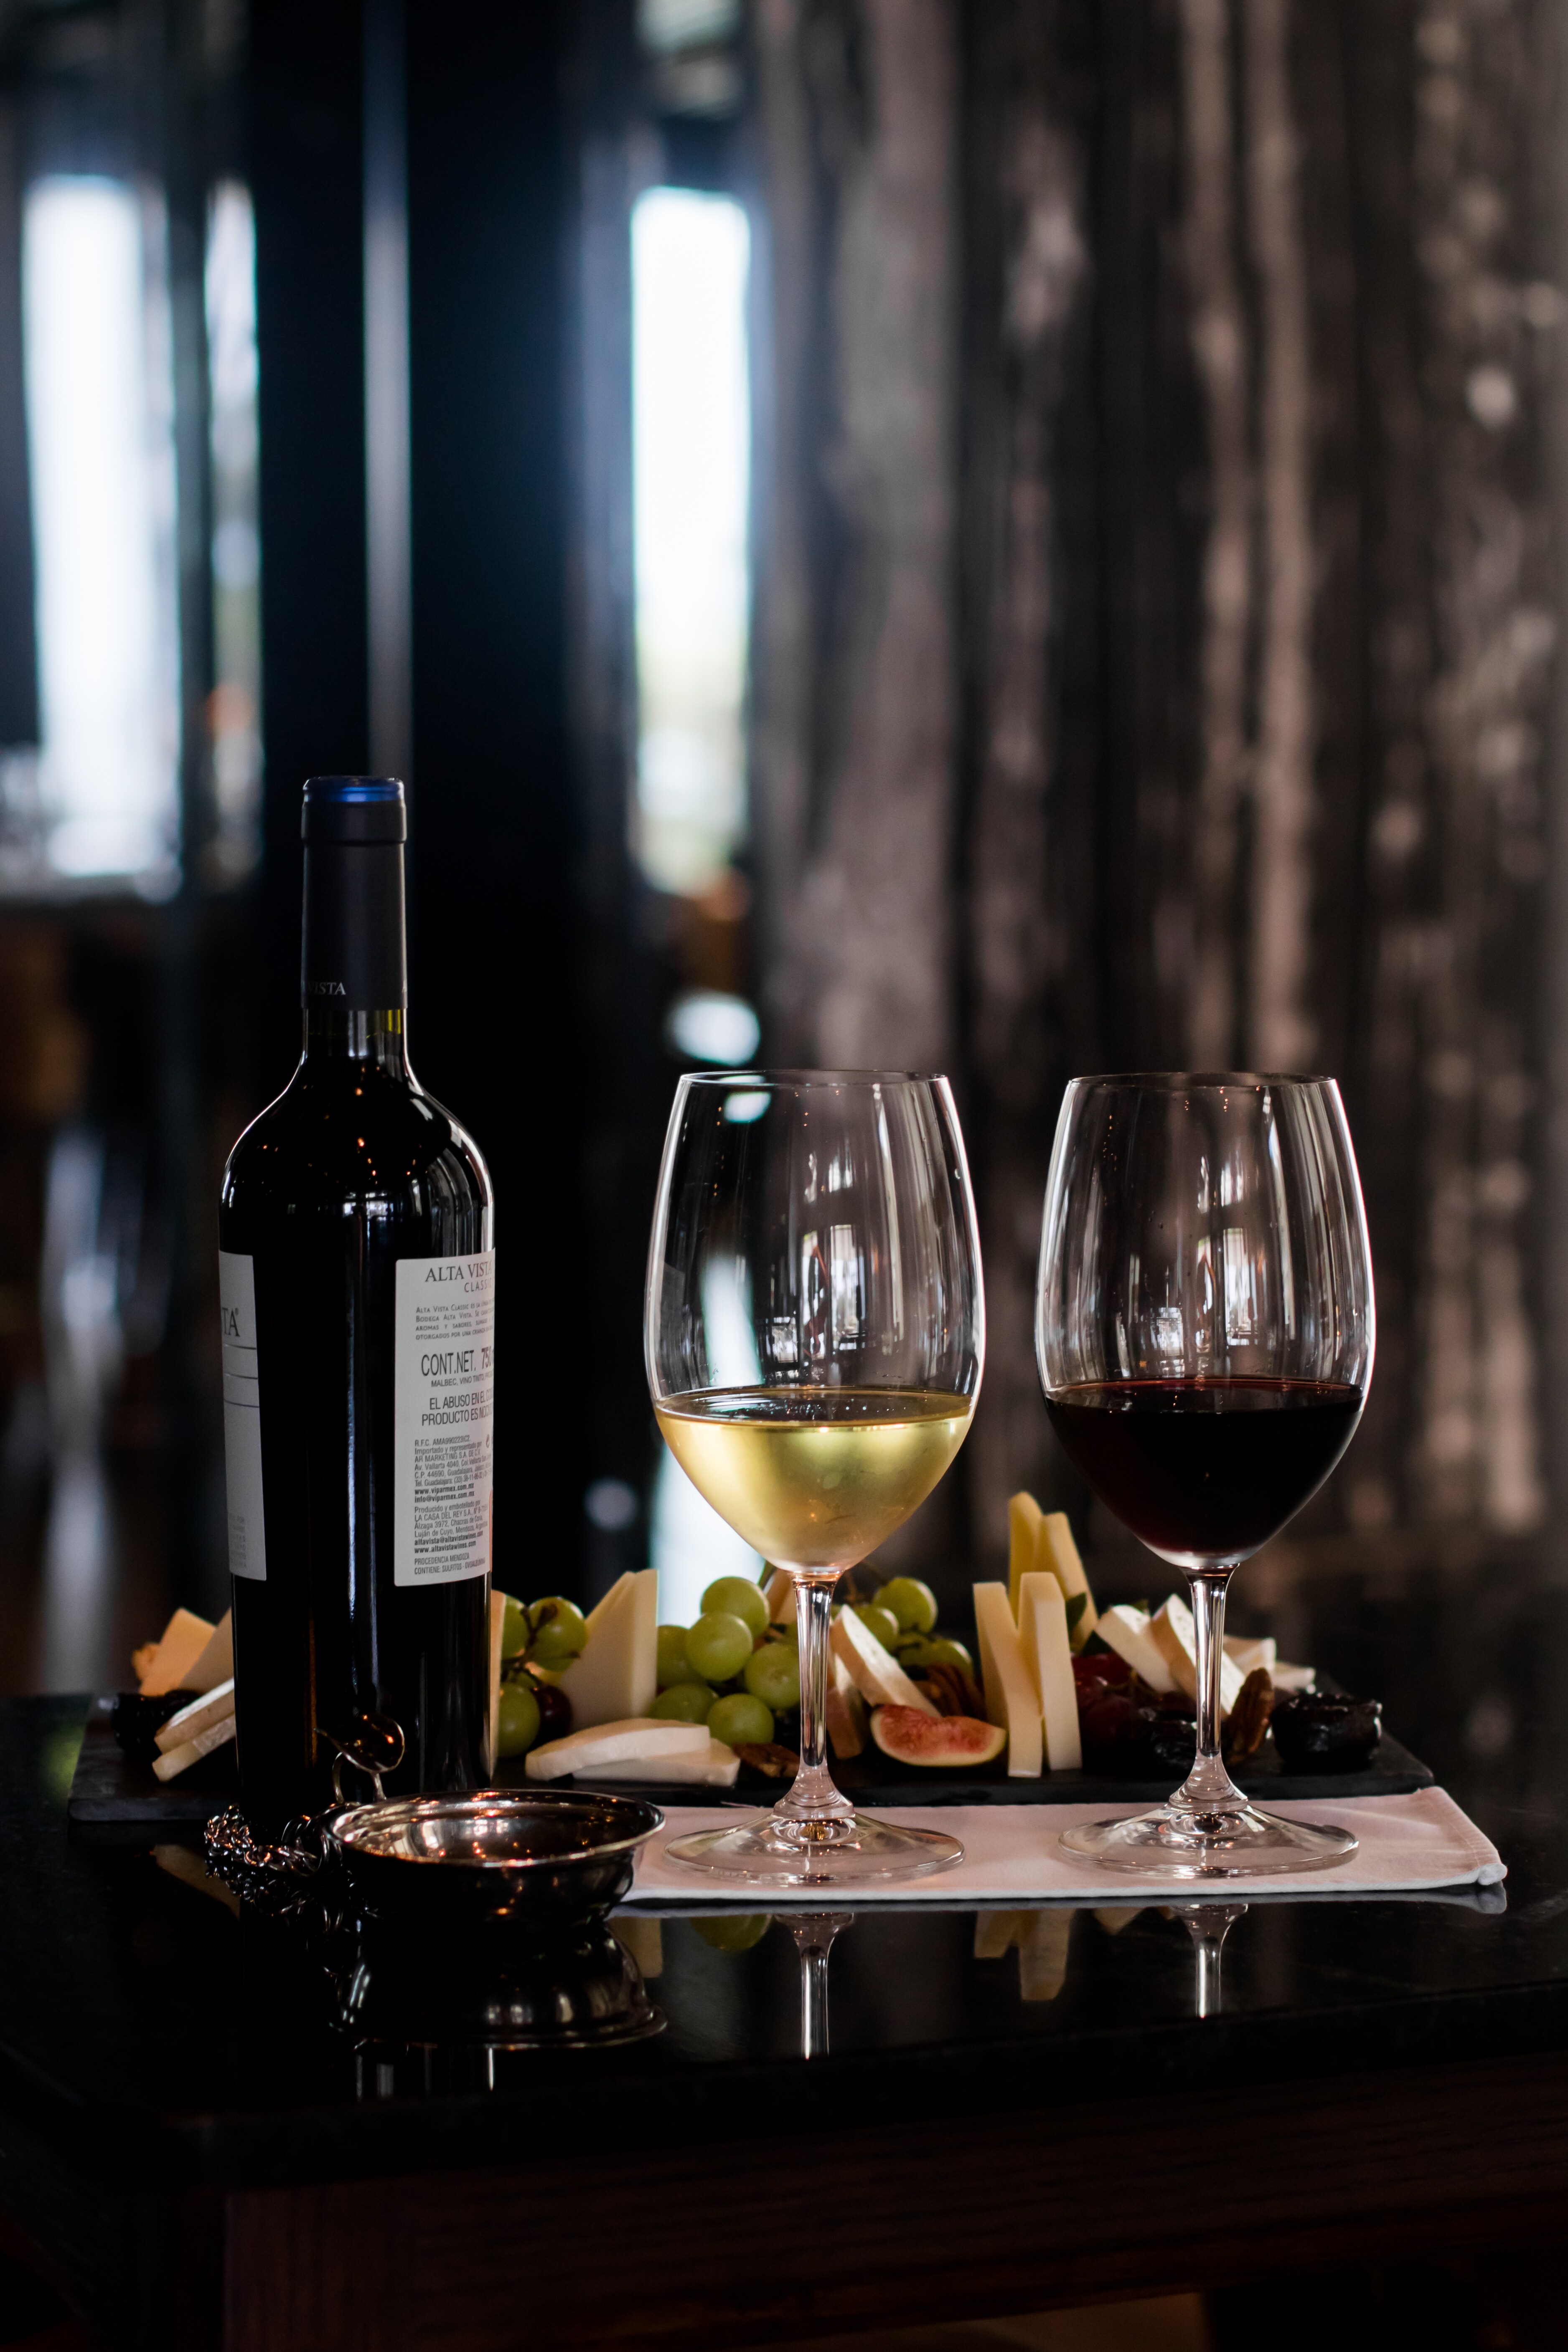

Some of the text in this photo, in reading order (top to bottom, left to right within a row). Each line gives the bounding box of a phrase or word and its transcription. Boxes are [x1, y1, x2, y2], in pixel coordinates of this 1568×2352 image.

[308, 981, 346, 995] VISTA
[425, 1260, 492, 1282] ALTA VISTA
[460, 1376, 472, 1384] VINO
[429, 1398, 441, 1410] EL
[442, 1394, 470, 1409] ABUSO
[471, 1392, 479, 1405] EN
[480, 1391, 485, 1403] EL
[422, 1410, 470, 1426] PRODUCTO
[470, 1408, 478, 1420] ES
[415, 1447, 444, 1455] Importado
[450, 1443, 476, 1453] representado
[425, 1453, 457, 1462] MARKETING
[415, 1491, 474, 1503] info@viparmex.com.mx
[415, 1505, 443, 1513] Producido
[415, 1530, 430, 1539] Luján
[415, 1531, 483, 1545] altavista@altavistawines.com
[414, 1541, 476, 1553] www.altavistawines.com
[415, 1552, 470, 1565] PROCEDENCIA MENDOZA
[442, 1563, 462, 1572] SULFITOS
